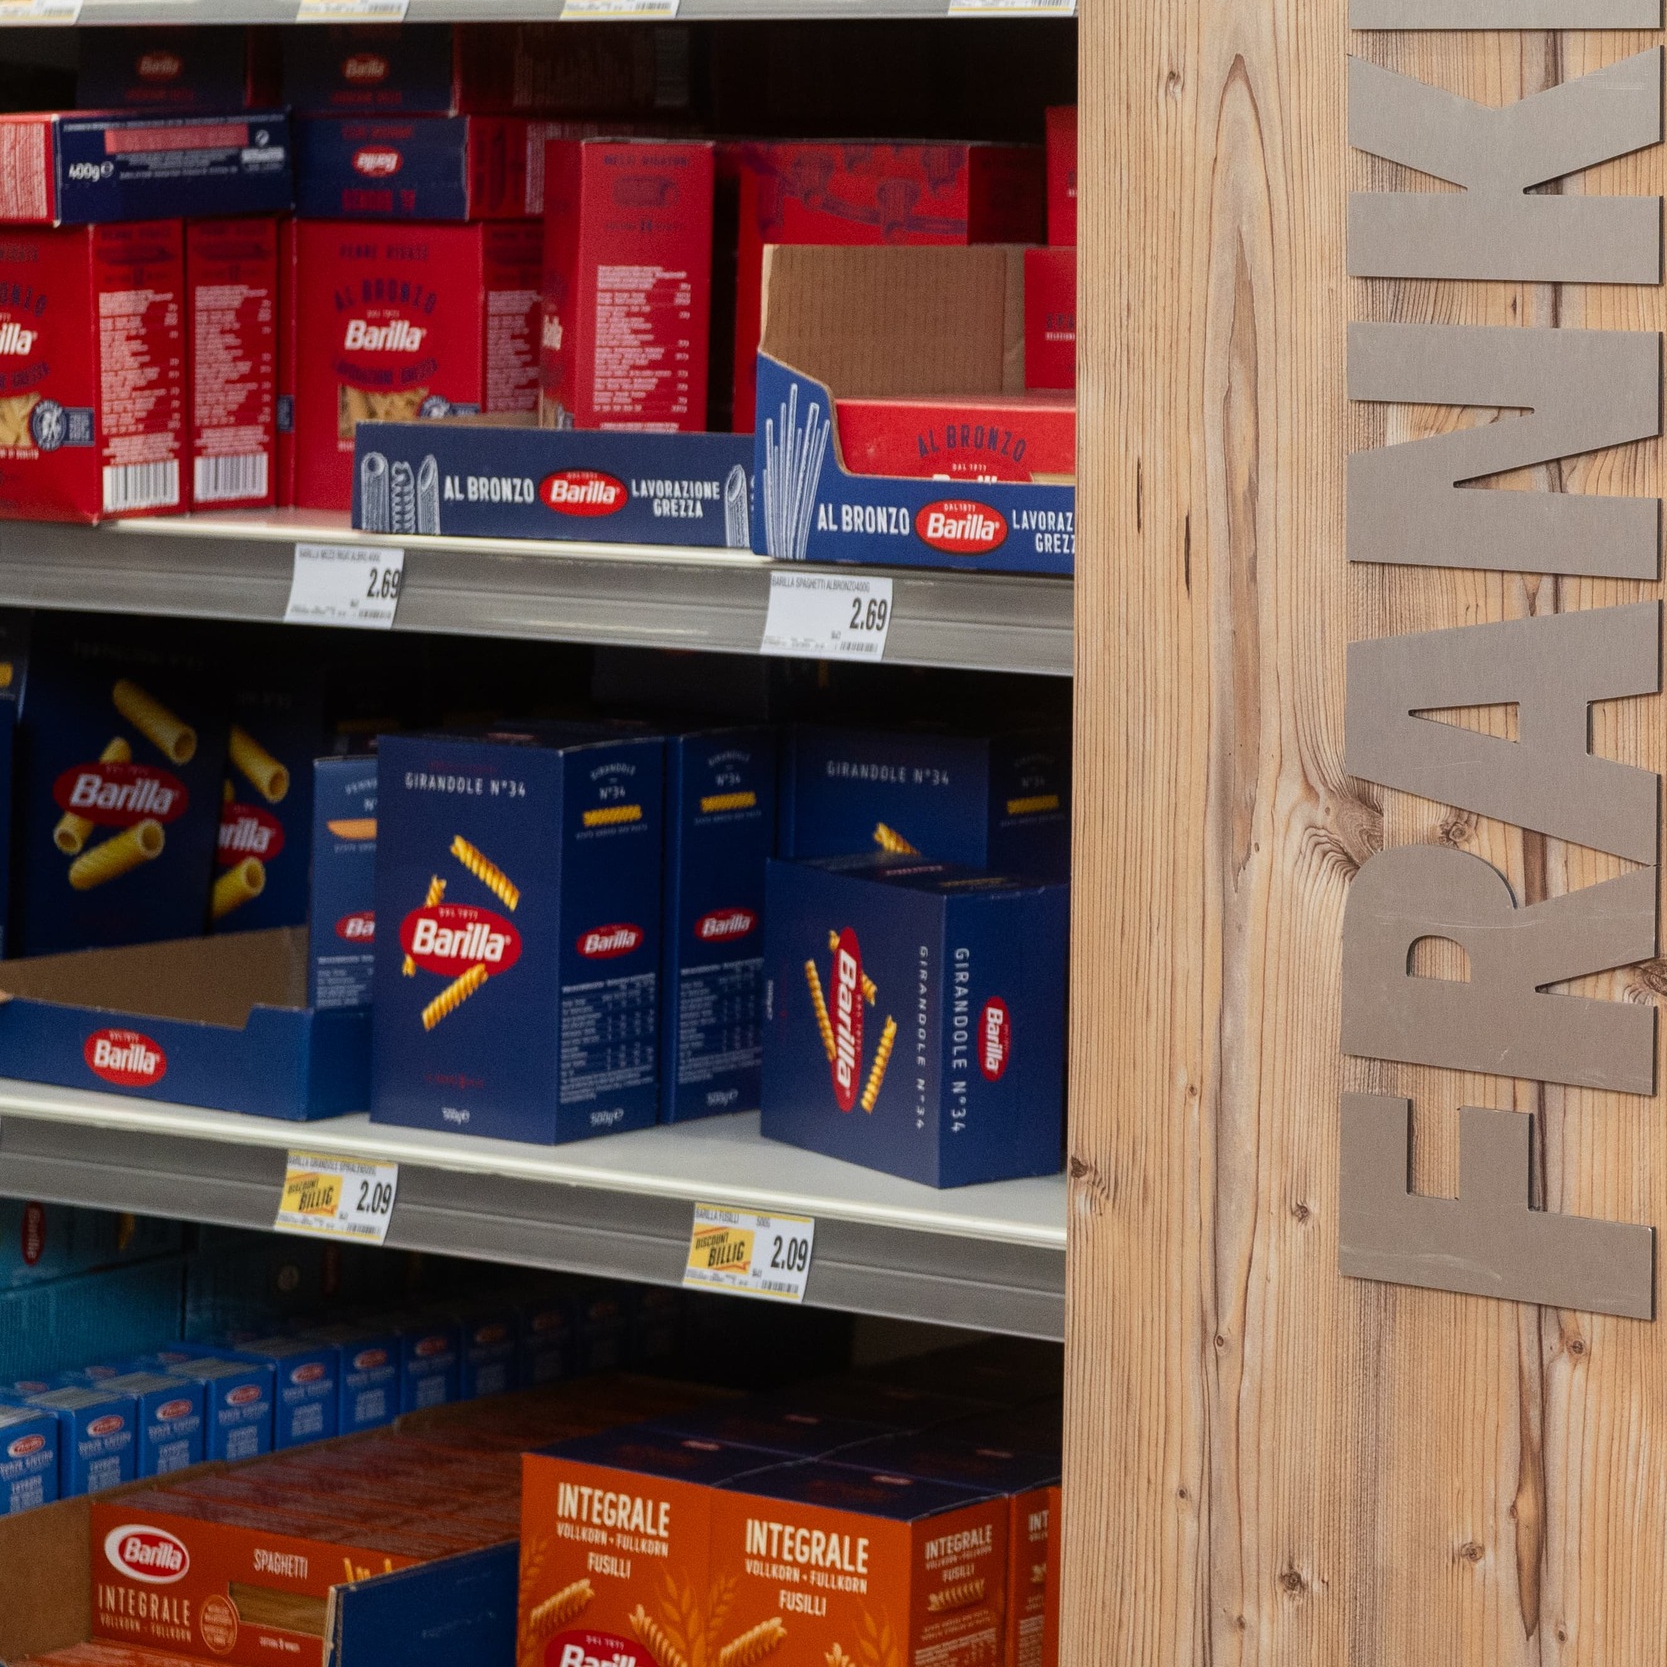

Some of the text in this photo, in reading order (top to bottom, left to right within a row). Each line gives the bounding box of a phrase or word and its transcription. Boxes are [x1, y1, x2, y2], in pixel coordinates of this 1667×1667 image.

[344, 321, 427, 353] Barilla
[444, 477, 534, 503] AL BRONZO
[551, 479, 620, 504] Barilla
[631, 479, 721, 501] LAVORAZIONE
[653, 498, 704, 518] GREZZA
[818, 503, 910, 536] AL BRONZO
[927, 513, 999, 541] Barilla
[367, 567, 401, 599] 2.69
[849, 597, 887, 631] 2.69
[69, 774, 180, 817] Barilla
[405, 772, 480, 794] GIRANDOLE
[411, 918, 511, 963] Barilla
[583, 928, 639, 954] Barilla
[702, 912, 754, 937] Barilla
[916, 944, 928, 1067] GIRANDOLE
[953, 947, 970, 1070] GIRANDOLE
[836, 949, 858, 1098] Barilla
[985, 1005, 1004, 1076] Barilla
[93, 1037, 160, 1074] Barilla
[357, 1180, 392, 1214] 2.09
[696, 1232, 729, 1249] DISCOUNT
[708, 1240, 745, 1268] BILLIG
[770, 1235, 808, 1272] 2.09
[558, 1482, 671, 1539] INTEGRALE
[124, 1538, 185, 1572] Barilla
[556, 1522, 669, 1557] VOLLKORN FULLKORN
[745, 1518, 869, 1575] INTEGRALE
[925, 1525, 992, 1561] INTEGRALE
[253, 1548, 309, 1579] SPAGHETTI
[587, 1551, 631, 1579] FUSILLI
[745, 1559, 868, 1594] VOLLKORN FULLKORN
[99, 1584, 191, 1628] INTEGRALE
[779, 1589, 826, 1617] FUSILLI
